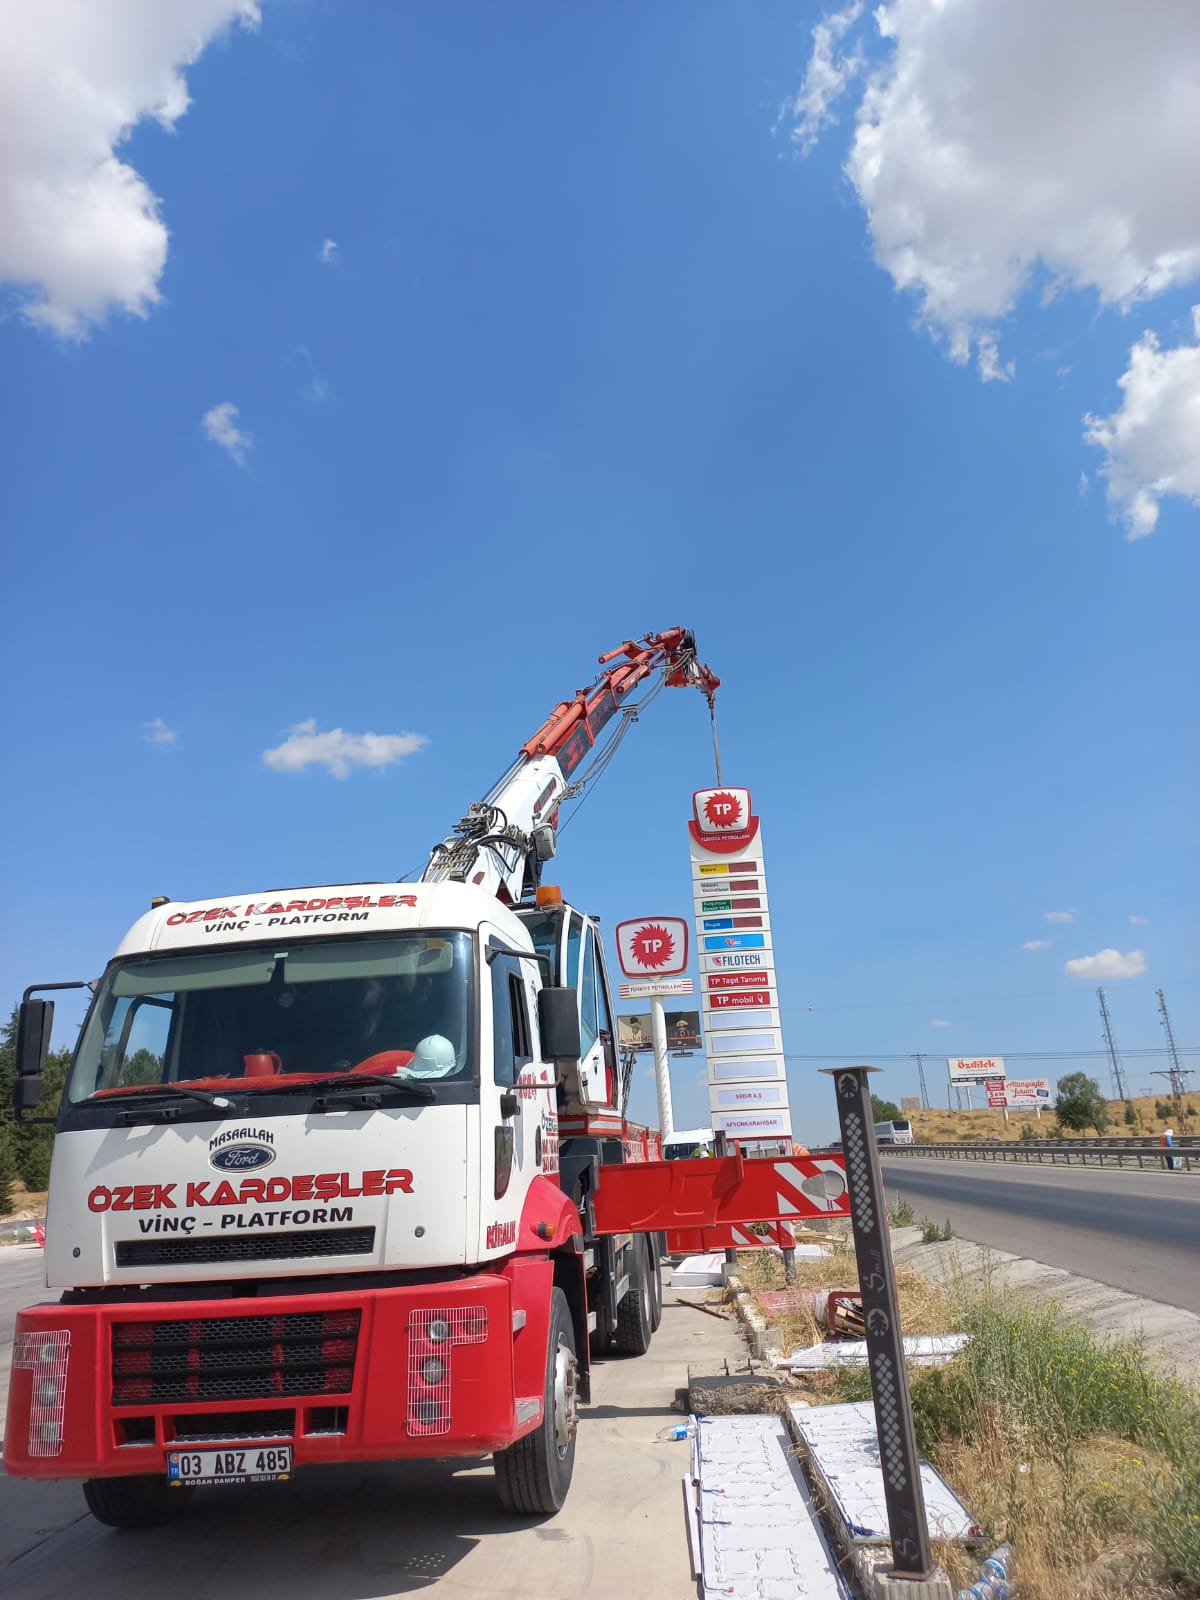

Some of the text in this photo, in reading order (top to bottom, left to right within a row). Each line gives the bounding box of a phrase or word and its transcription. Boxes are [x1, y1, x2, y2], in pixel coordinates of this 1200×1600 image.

[713, 803, 732, 816] TP
[205, 921, 250, 933] VİNÇ
[268, 912, 370, 926] PLATFORM
[642, 939, 662, 954] TP
[717, 995, 754, 1005] TP mobil
[209, 1128, 274, 1151] MASAALLAH
[224, 1149, 260, 1166] Ford
[88, 1168, 414, 1213] ÖZEK KARDEŞLER
[138, 1214, 196, 1234] VİNÇ
[221, 1206, 353, 1229] PLATFORM
[181, 1449, 288, 1476] 03 ABZ 485
[214, 1476, 246, 1485] DAMPER
